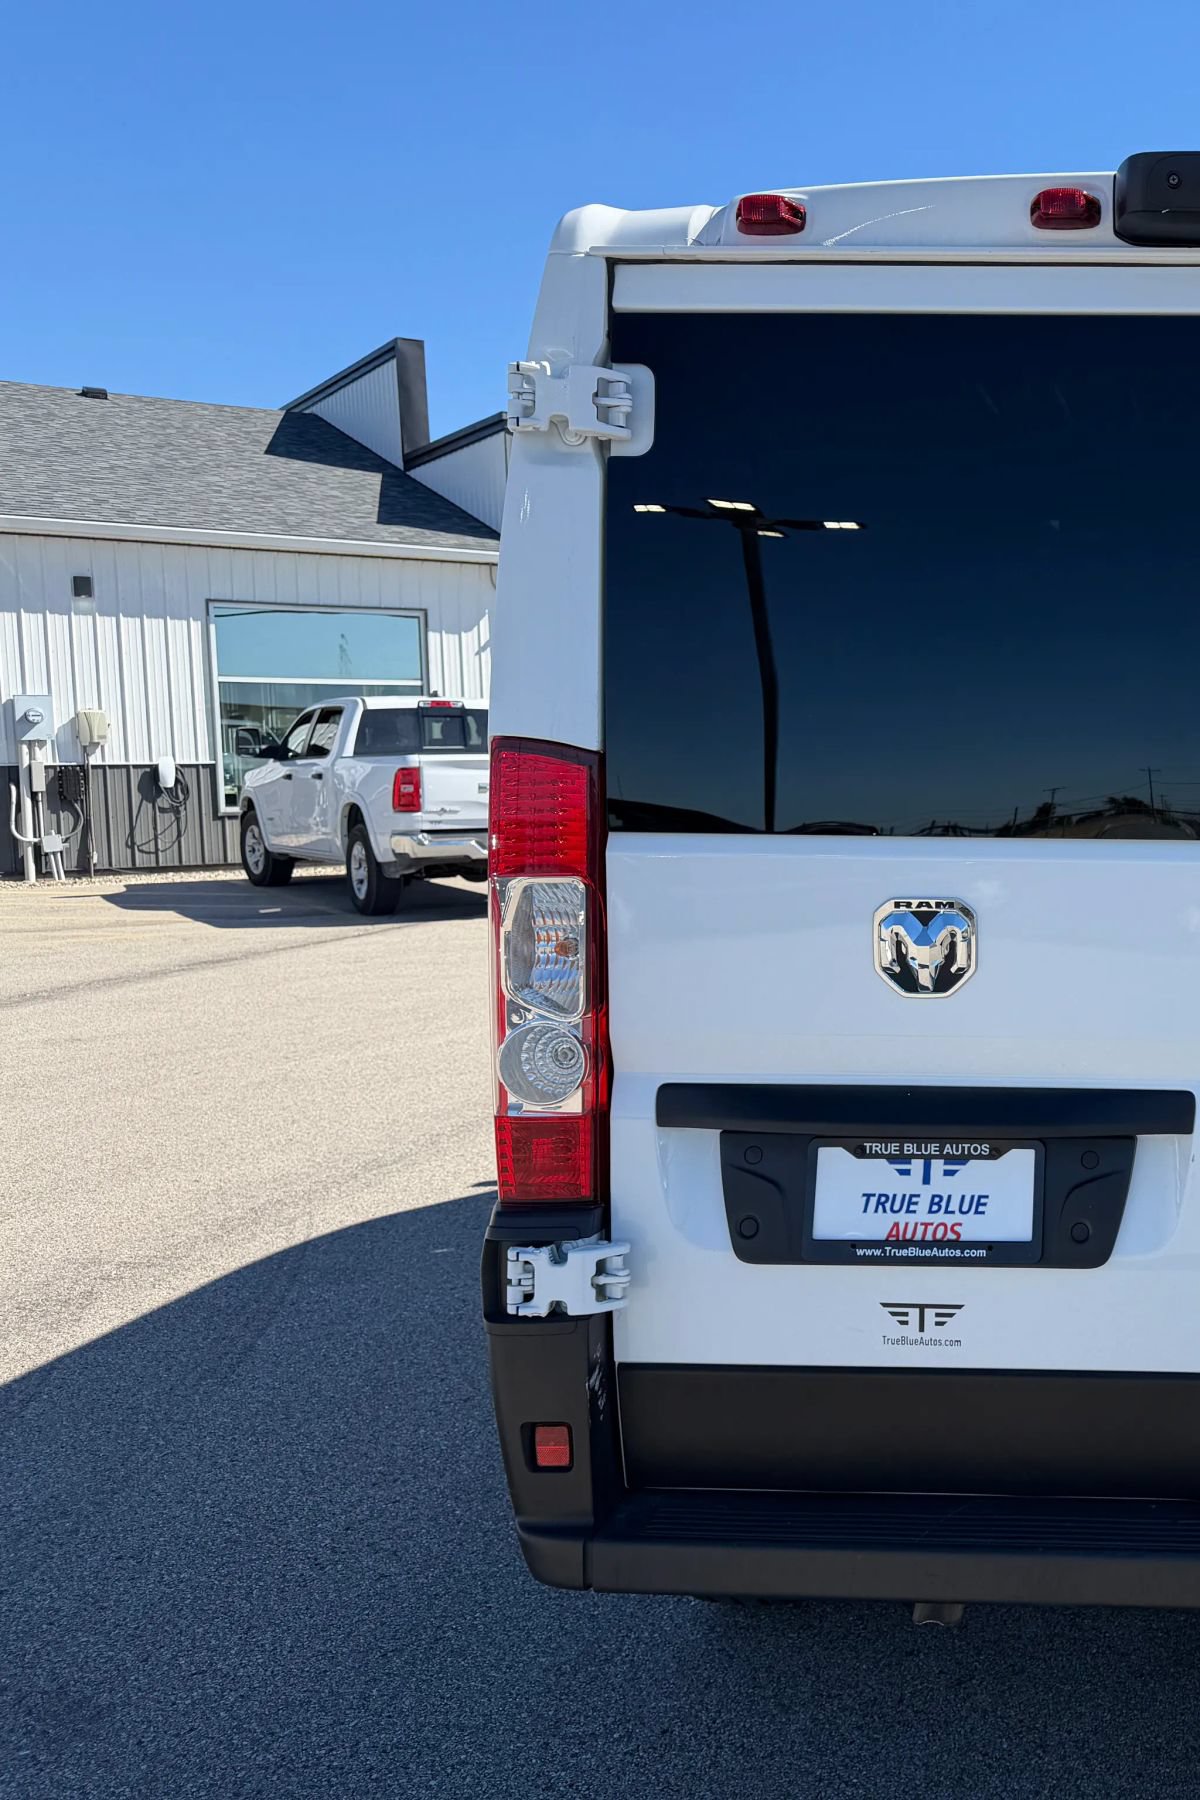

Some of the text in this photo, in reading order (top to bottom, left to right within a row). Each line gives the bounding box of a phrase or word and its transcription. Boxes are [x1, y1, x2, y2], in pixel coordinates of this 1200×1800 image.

[893, 901, 955, 909] RAM
[863, 1143, 990, 1155] TRUE BLUE AUTOS
[861, 1193, 990, 1215] TRUE BLUE
[885, 1221, 963, 1241] AUTOS
[855, 1246, 987, 1258] www.TrueBlueAutos.com
[881, 1335, 962, 1347] TrueBlueAutos.com
